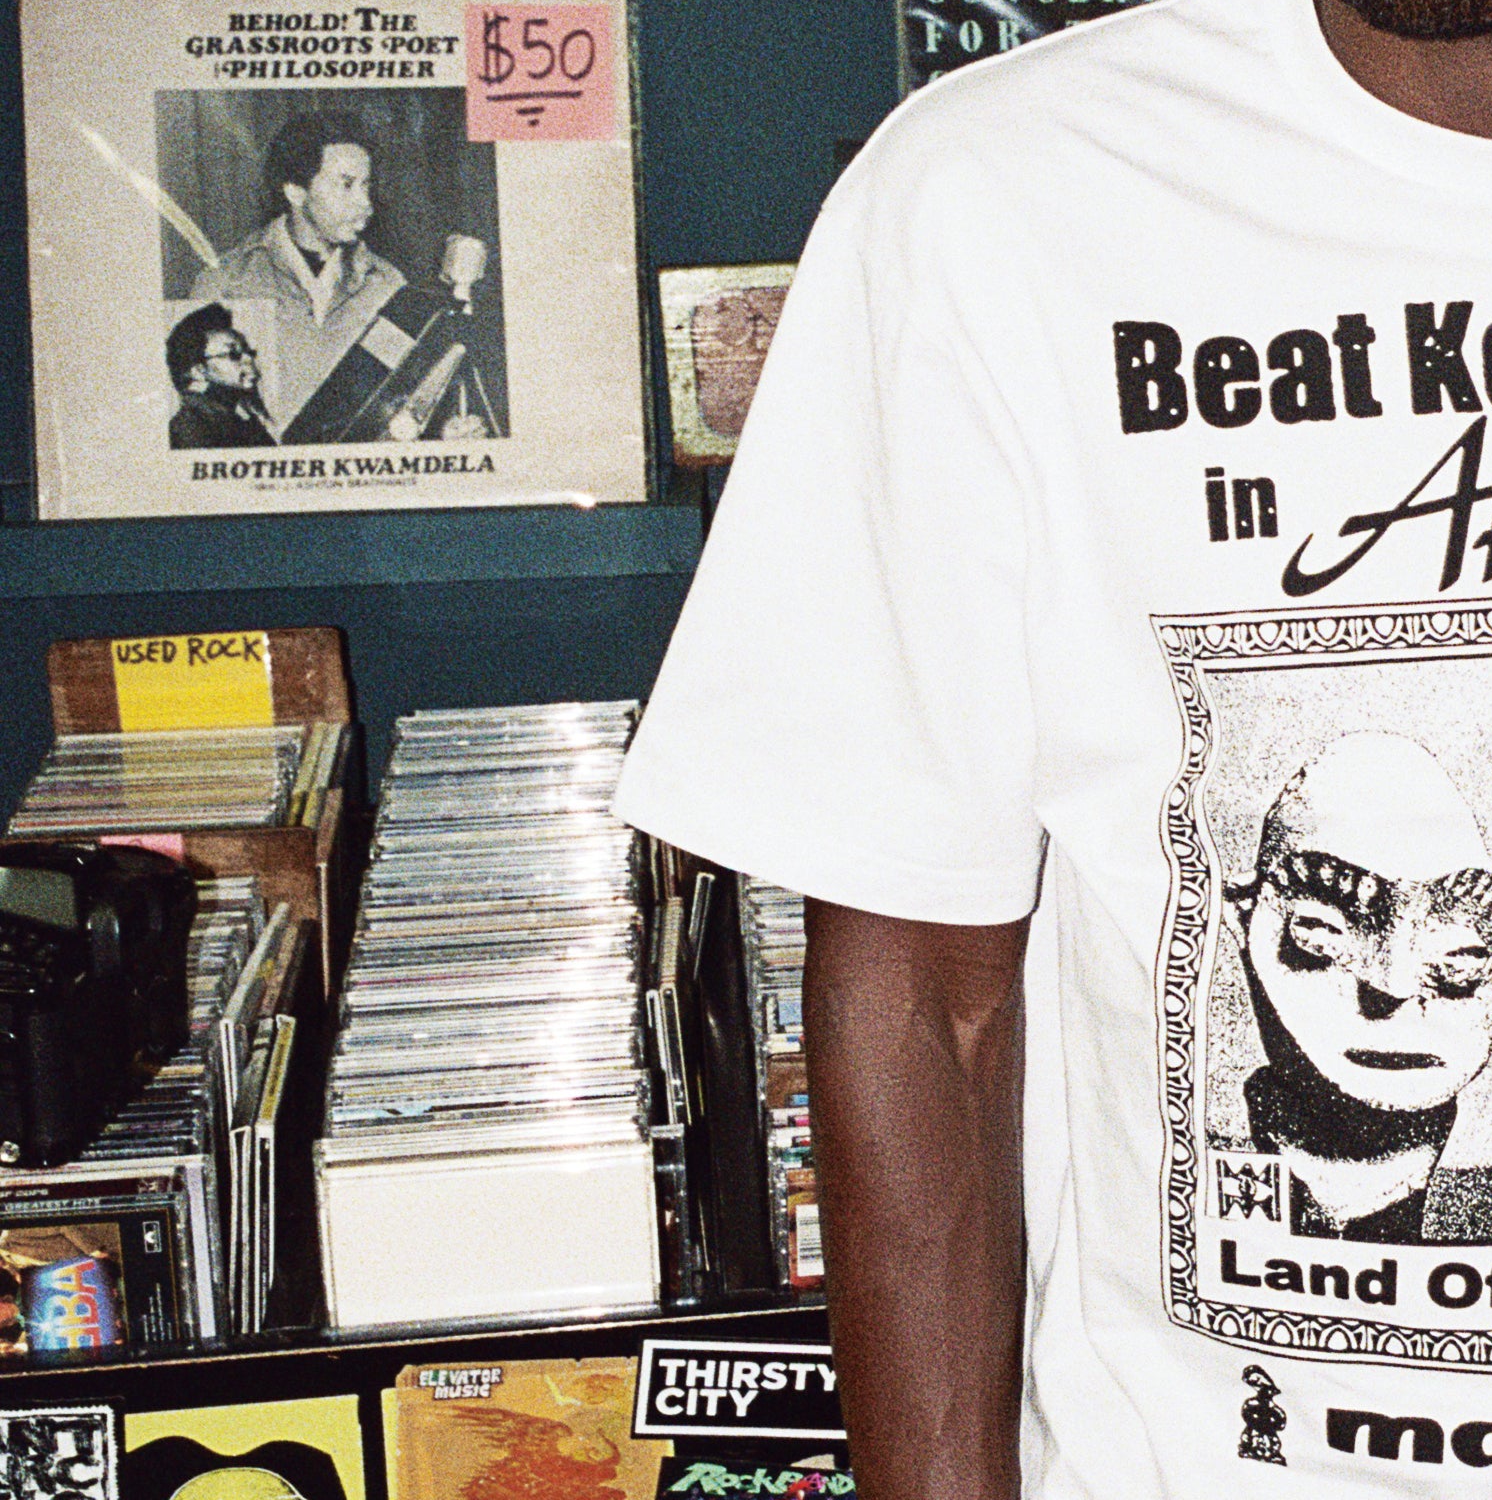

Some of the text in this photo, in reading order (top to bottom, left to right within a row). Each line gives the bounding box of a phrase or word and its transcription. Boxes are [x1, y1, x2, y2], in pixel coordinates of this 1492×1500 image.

[228, 8, 417, 33] BEHOLD! THE
[185, 35, 373, 58] GRASSROOTS
[477, 12, 596, 85] $50
[925, 20, 1022, 53] FOR
[1113, 313, 1383, 433] Beat
[191, 460, 328, 482] BROTHER
[1205, 465, 1278, 543] in
[117, 636, 263, 666] USED ROCK
[1219, 1239, 1398, 1307] Land
[657, 1359, 836, 1392] THIRSTY
[434, 1384, 491, 1400] MUSIC
[655, 1390, 758, 1418] CITY
